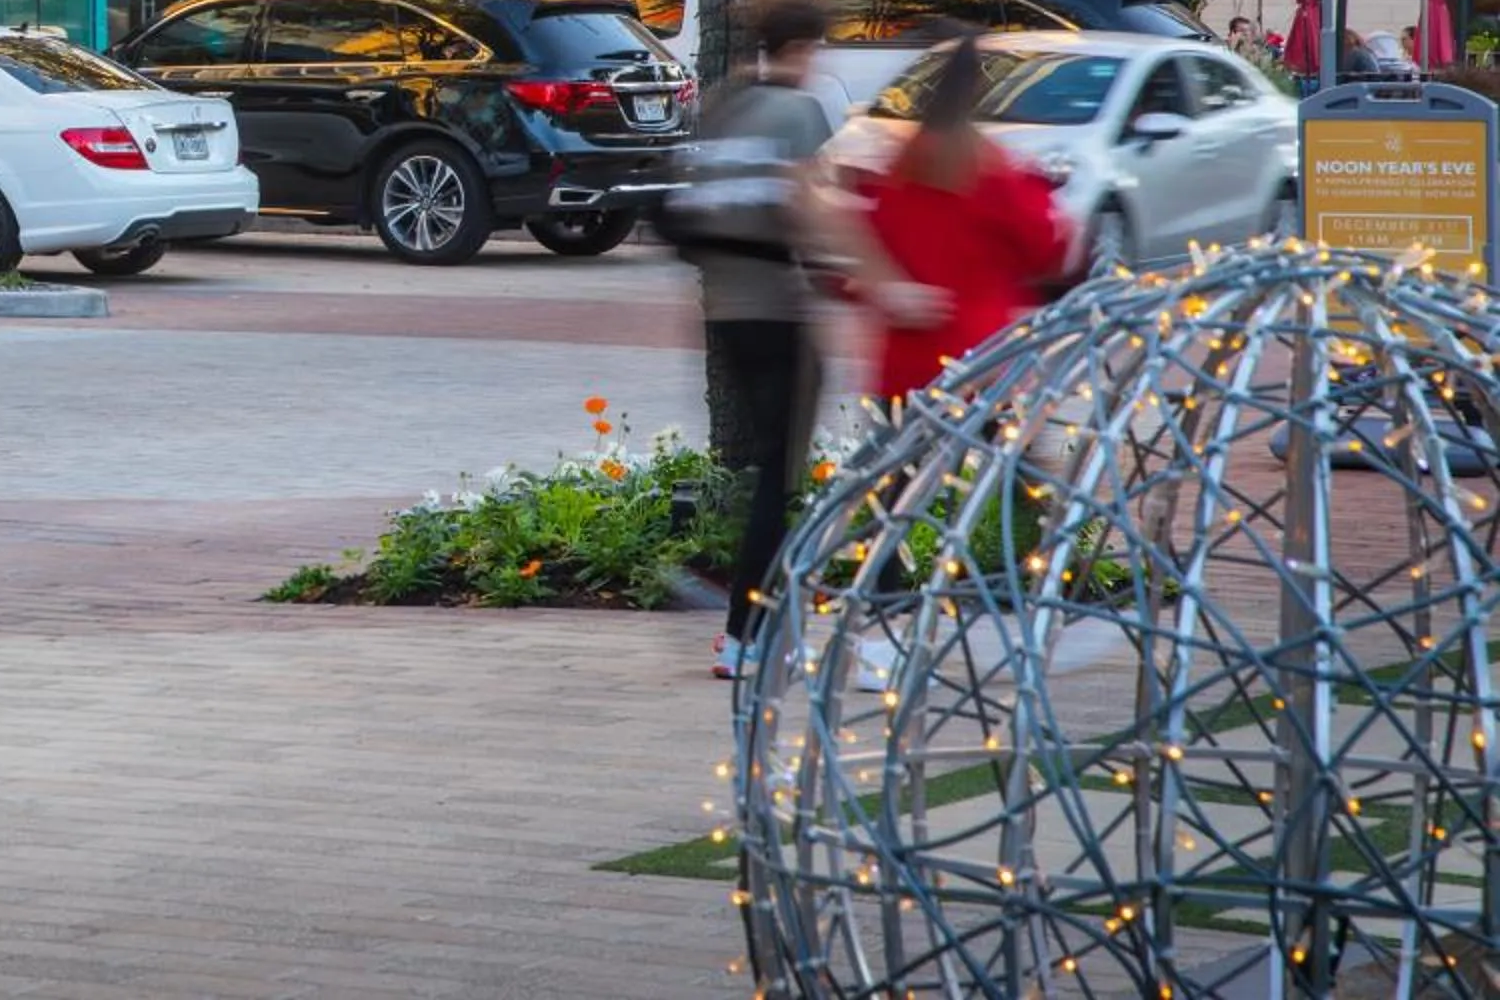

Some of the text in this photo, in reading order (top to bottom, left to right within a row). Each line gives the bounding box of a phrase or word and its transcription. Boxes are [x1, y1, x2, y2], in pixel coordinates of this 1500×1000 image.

[1316, 160, 1477, 176] NOON YEAR'S EVE
[1333, 218, 1419, 232] DECEMBER
